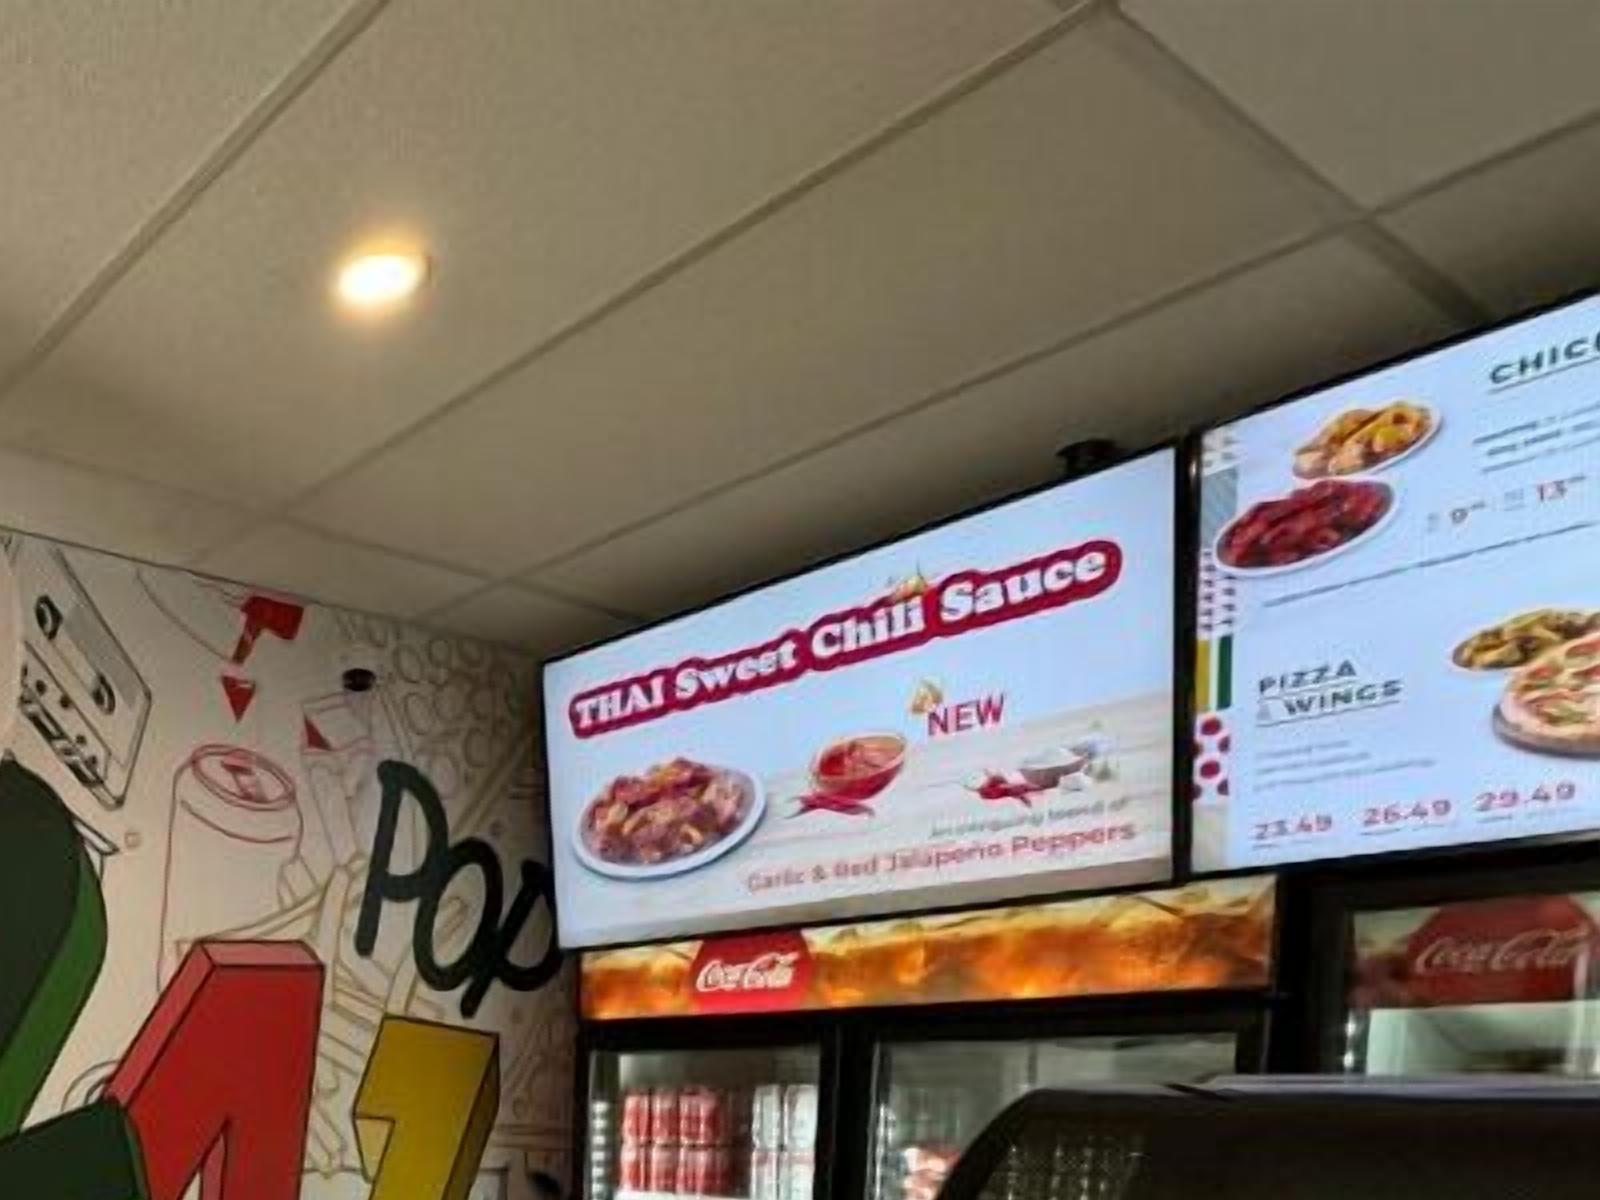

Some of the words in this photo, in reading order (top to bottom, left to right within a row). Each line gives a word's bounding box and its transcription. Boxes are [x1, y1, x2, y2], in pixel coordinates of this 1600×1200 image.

[576, 675, 665, 729] THAI
[675, 640, 797, 699] Sweet
[812, 595, 926, 658] Chili
[940, 551, 1107, 622] Sauce
[1258, 659, 1357, 694] PIZZA
[1283, 679, 1404, 716] WINGS
[928, 692, 1005, 736] NEW
[1362, 798, 1451, 828] 26.49
[1474, 782, 1576, 813] 29.49
[1011, 823, 1138, 858] Peppers
[1415, 922, 1589, 976] Coca-Cola
[696, 951, 800, 992] Coca-Cola
